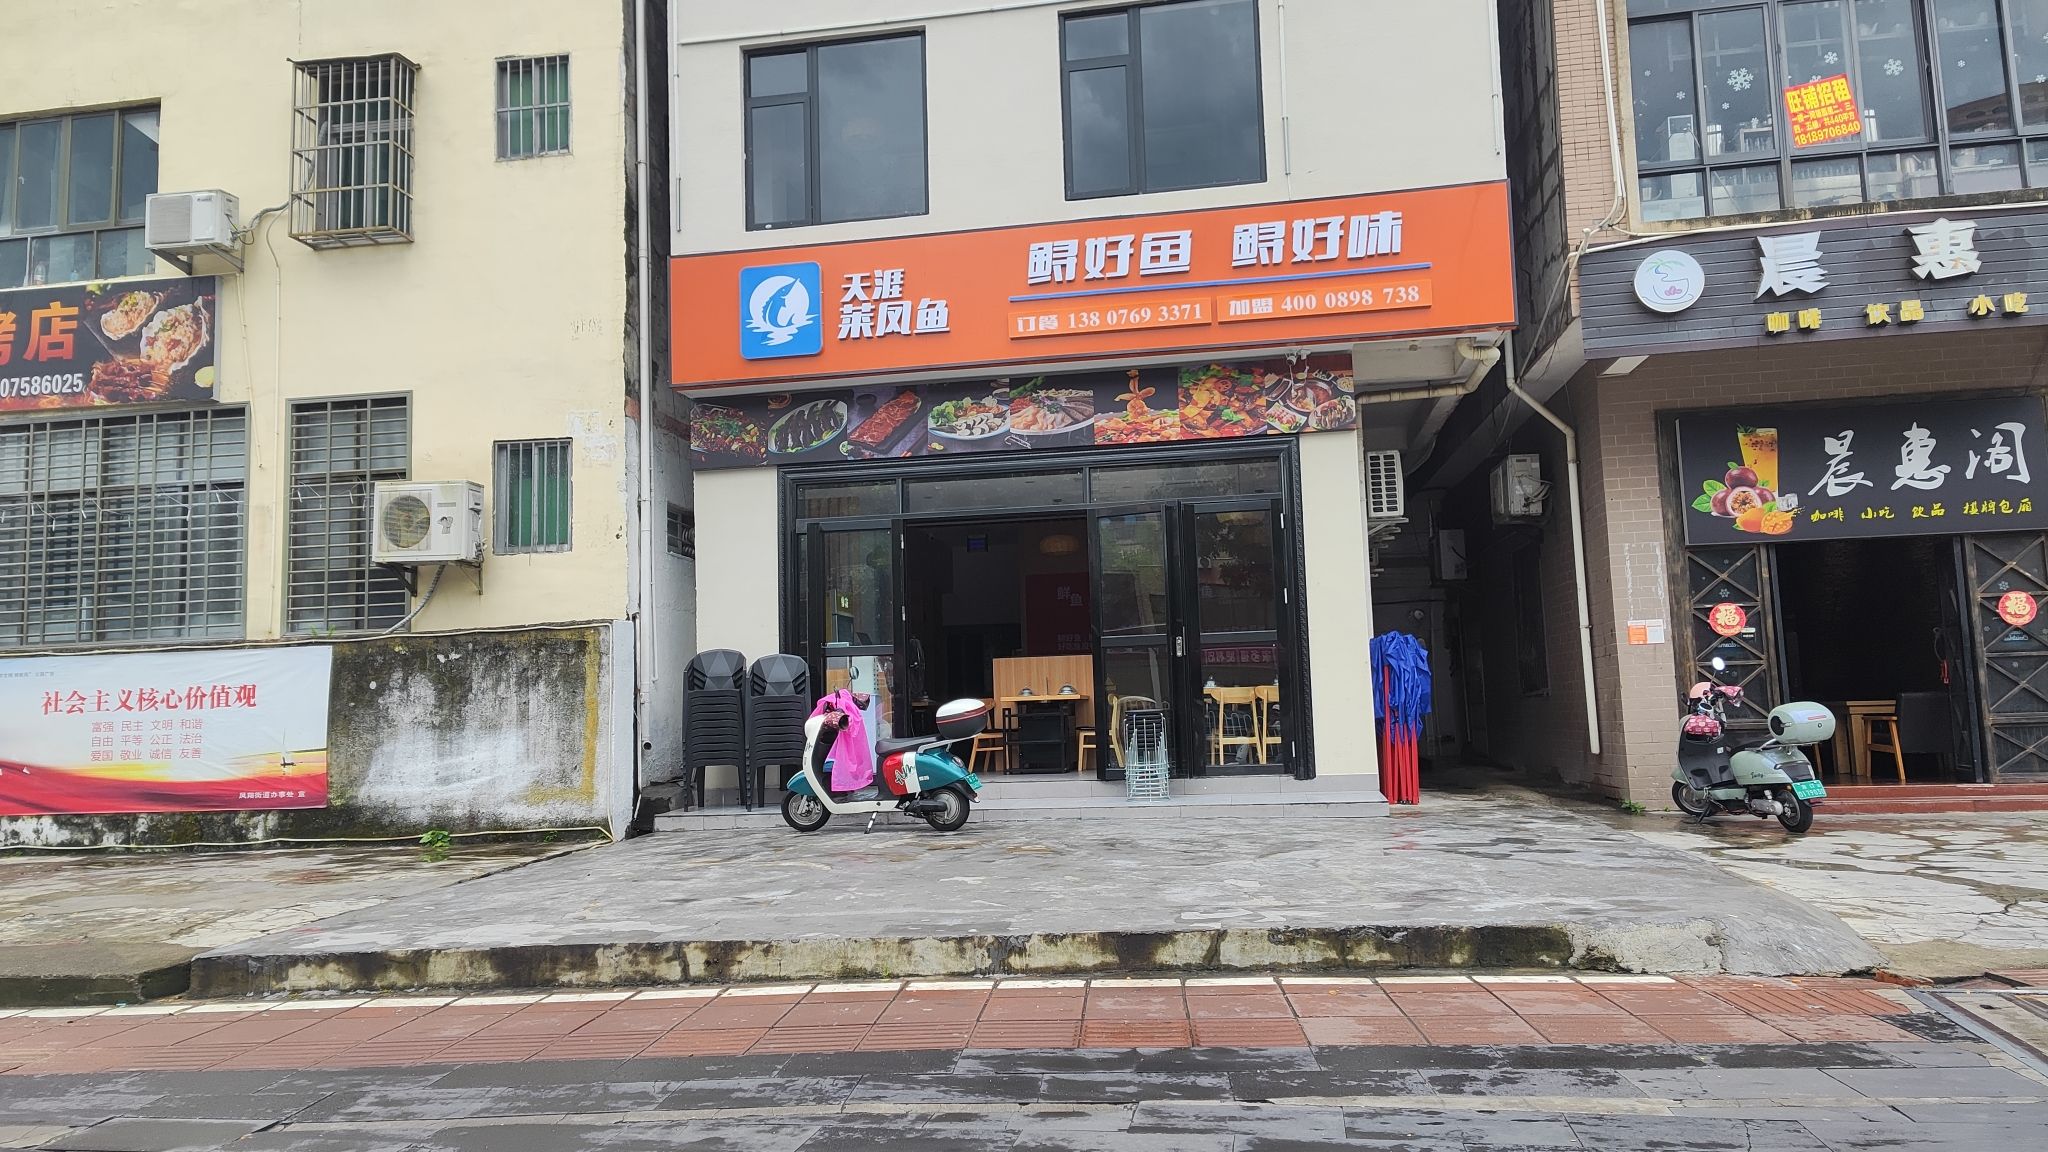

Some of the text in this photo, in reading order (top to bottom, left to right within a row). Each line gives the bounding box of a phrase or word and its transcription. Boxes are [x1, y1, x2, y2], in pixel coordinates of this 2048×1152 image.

[1786, 78, 1851, 113] 旺铺招租
[1795, 121, 1861, 145] 18189706840
[839, 268, 905, 302] 天涯
[1229, 286, 1420, 316] 加盟 400 0898 738
[1765, 291, 2030, 335] 咖啡 饮品 小吃
[837, 297, 950, 339] 莱凤鱼
[1017, 303, 1202, 332] 订餐 138 0769 3371
[0, 373, 83, 398] 07586025
[1810, 498, 2033, 523] 咖啡 小吃 饮品 棋牌包厢
[1715, 605, 1740, 626] 福
[2005, 593, 2031, 615] 福
[41, 684, 257, 716] 社会主义核心价值观
[92, 718, 203, 733] 富强 民主 文明 和谐
[91, 733, 202, 747] 自由 平等 公正 法治
[91, 747, 201, 762] 爱国 敬业 诚信 友善
